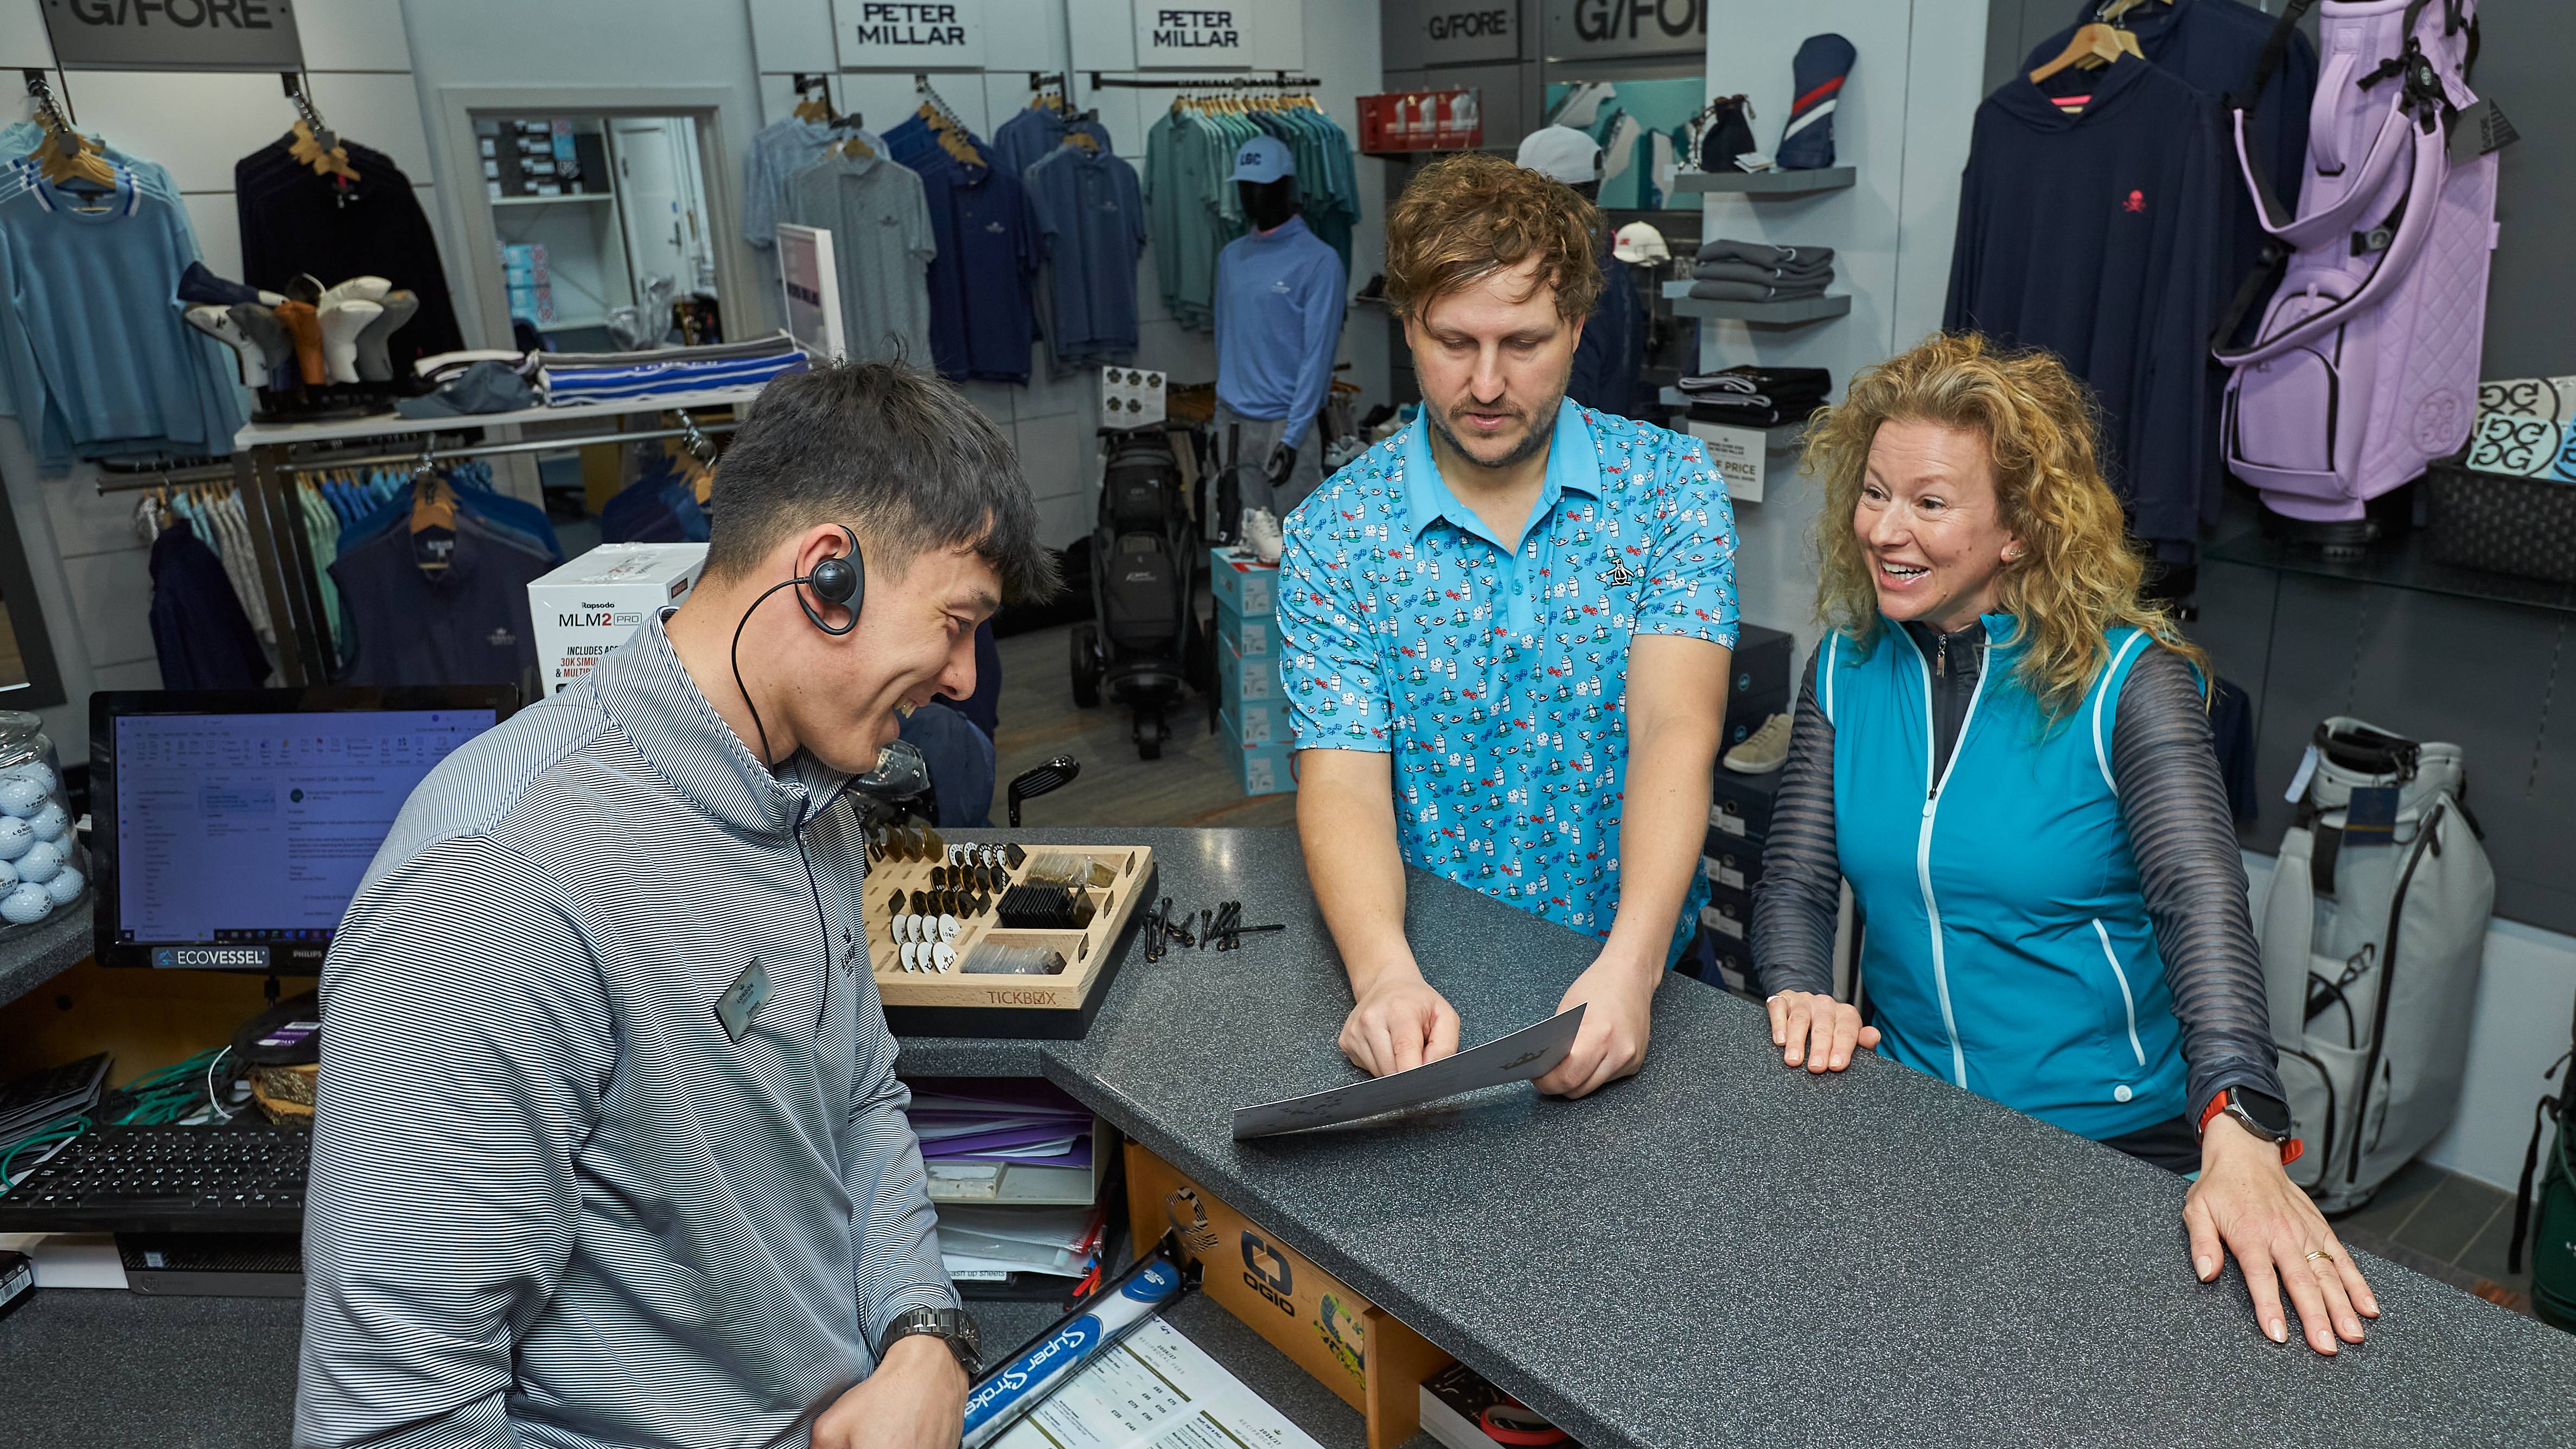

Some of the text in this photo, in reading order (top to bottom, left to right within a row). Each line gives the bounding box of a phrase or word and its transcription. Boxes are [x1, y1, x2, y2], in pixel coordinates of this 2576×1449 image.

[71, 0, 272, 29] G/FORE
[863, 3, 956, 23] PETER
[1159, 10, 1232, 28] PETER
[1575, 0, 1706, 42] G/FO
[1429, 9, 1507, 40] G/FORE
[858, 25, 965, 45] MILLAR
[1153, 30, 1239, 47] MILLAR
[1725, 461, 1756, 475] PRICE
[559, 613, 612, 627] MLM2
[568, 646, 603, 655] INCLUDES
[561, 658, 575, 666] 30K
[556, 668, 561, 677] &
[737, 982, 754, 1004] LONDON
[746, 1000, 761, 1019] James
[1243, 1272, 1295, 1317] OGIO
[1028, 1323, 1085, 1371] Super
[1139, 1337, 1185, 1375] RECIPROCAL FEES
[1239, 1419, 1274, 1449] RECIPROCAL
[1259, 1428, 1281, 1446] 2026/27
